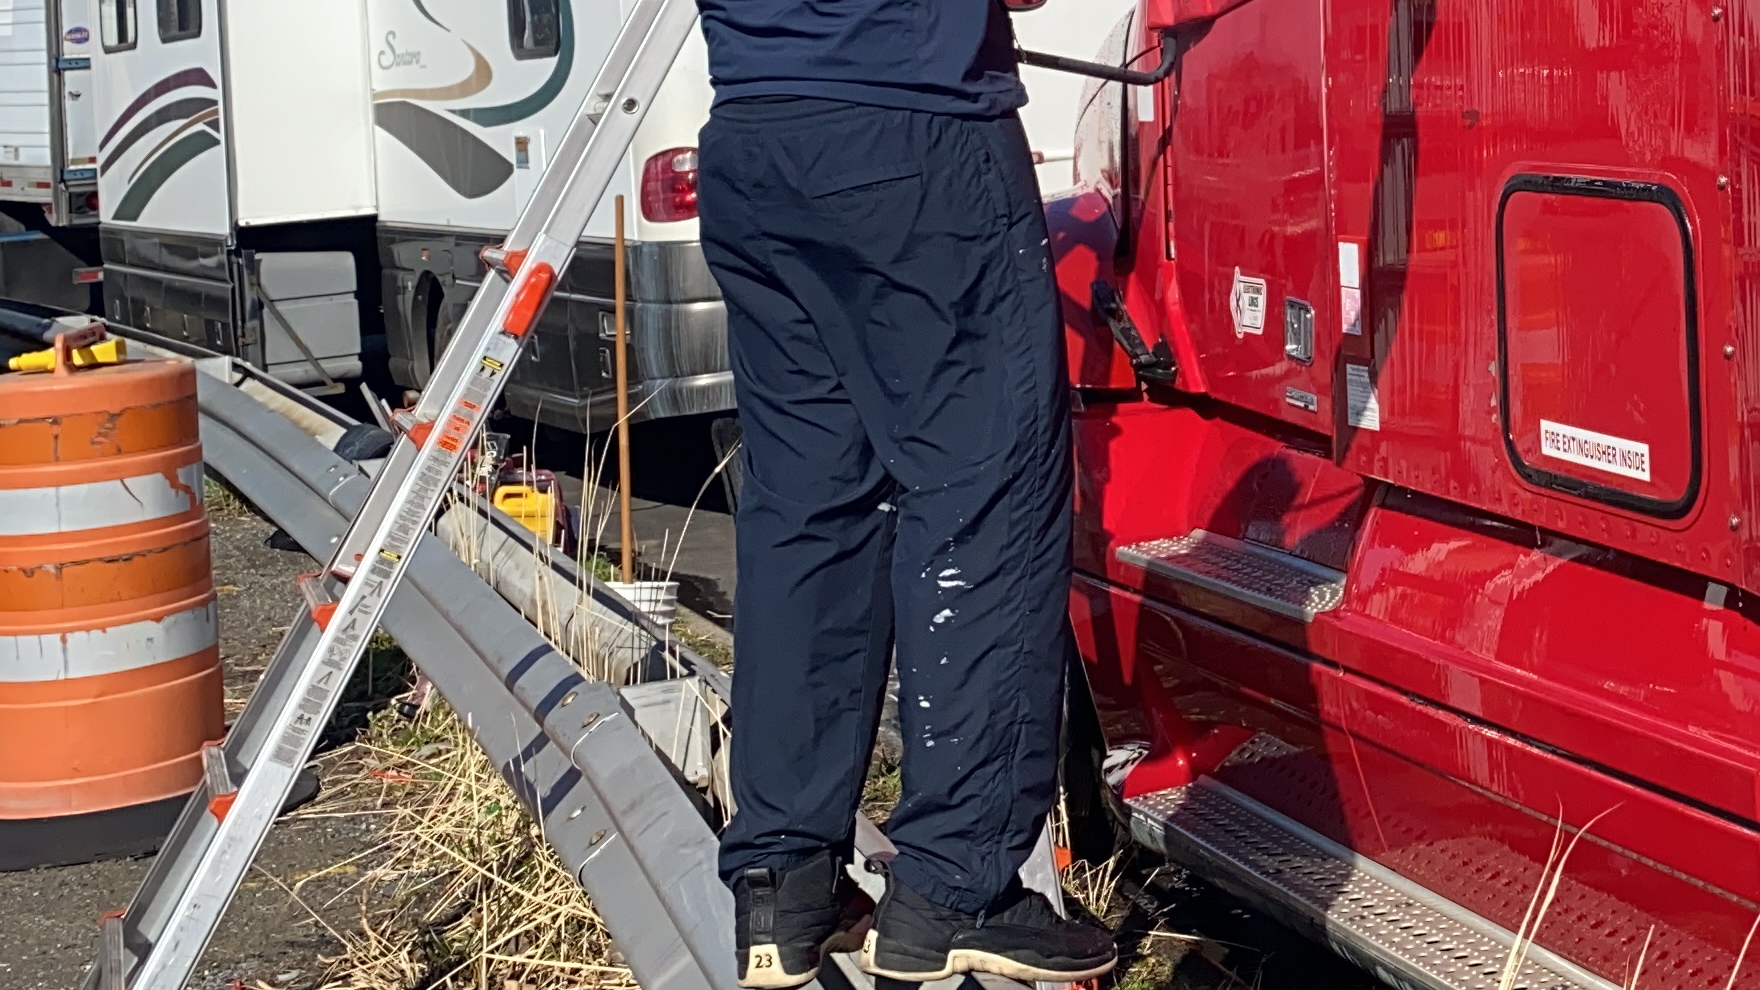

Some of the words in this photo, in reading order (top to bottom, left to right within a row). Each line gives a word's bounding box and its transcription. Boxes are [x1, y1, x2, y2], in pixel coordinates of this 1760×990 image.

[1545, 429, 1560, 451] FIRE
[1562, 434, 1617, 466] EXTINGUISHER
[1619, 447, 1646, 472] INSIDE
[754, 953, 773, 969] 23
